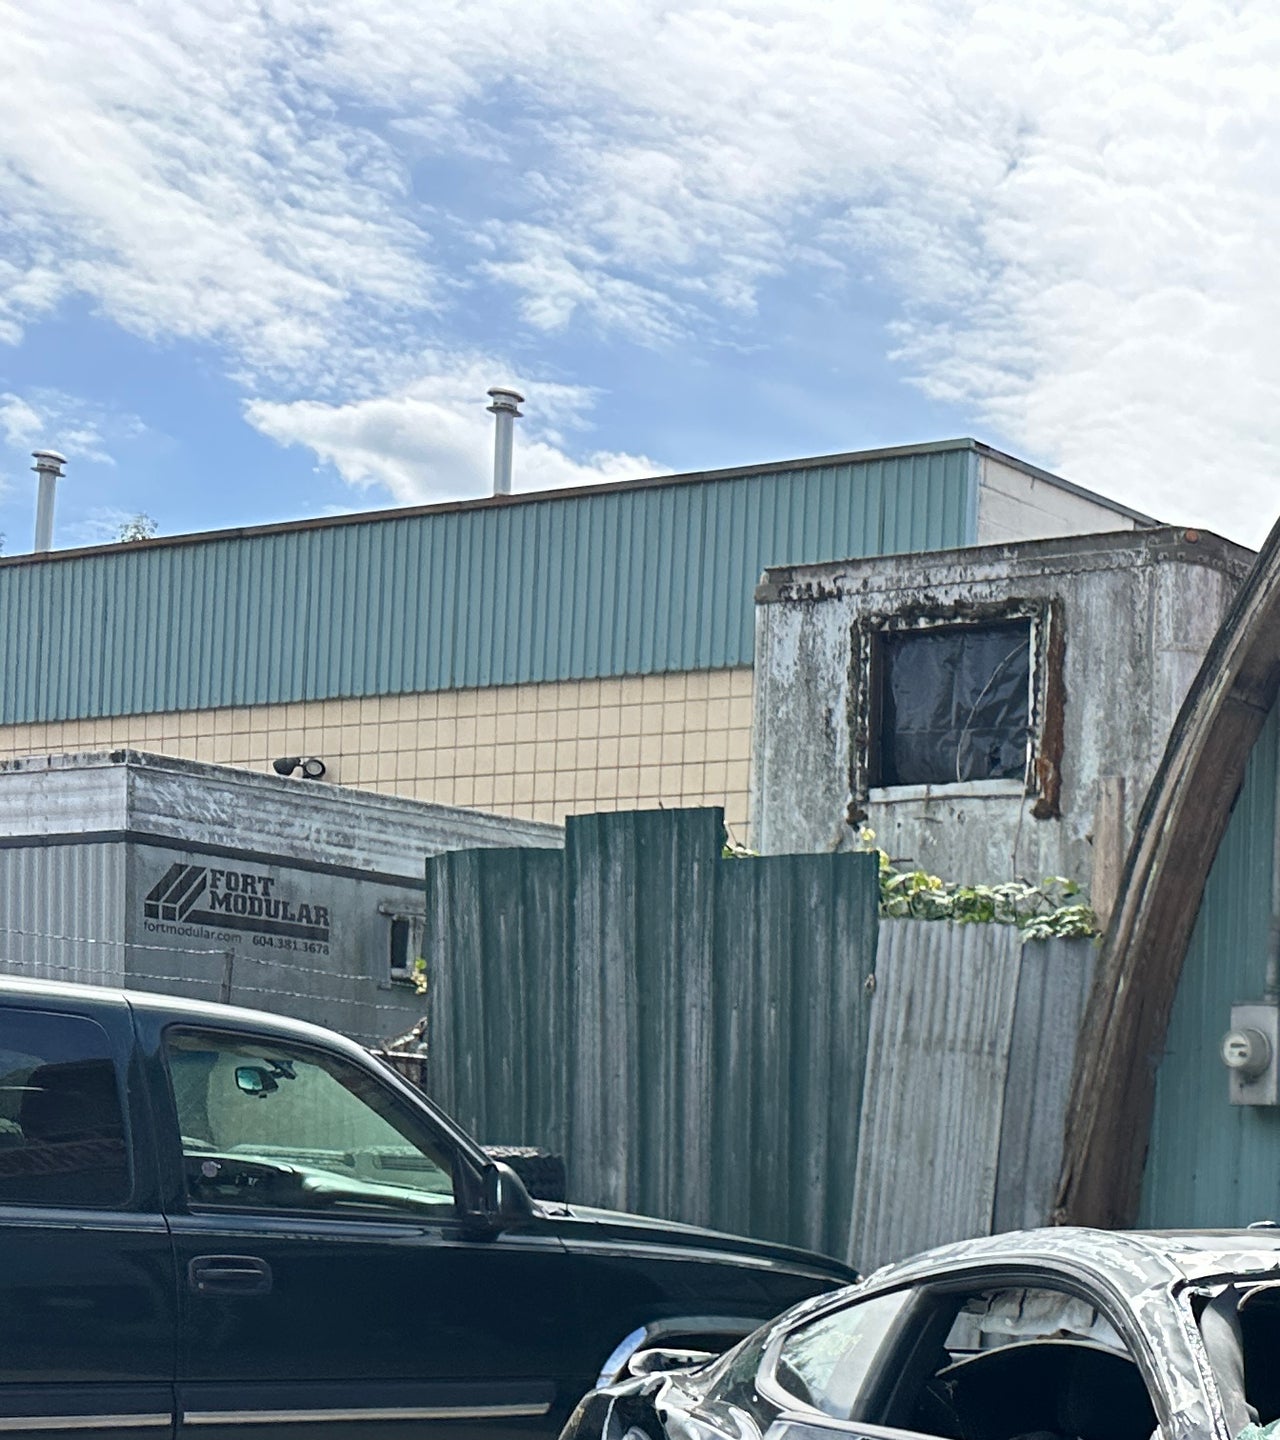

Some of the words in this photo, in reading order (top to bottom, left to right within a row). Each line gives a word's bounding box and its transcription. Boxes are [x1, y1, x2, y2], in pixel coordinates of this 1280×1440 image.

[209, 869, 275, 897] FORT
[209, 890, 330, 927] MODULAR
[143, 920, 242, 944] fortmodular.com
